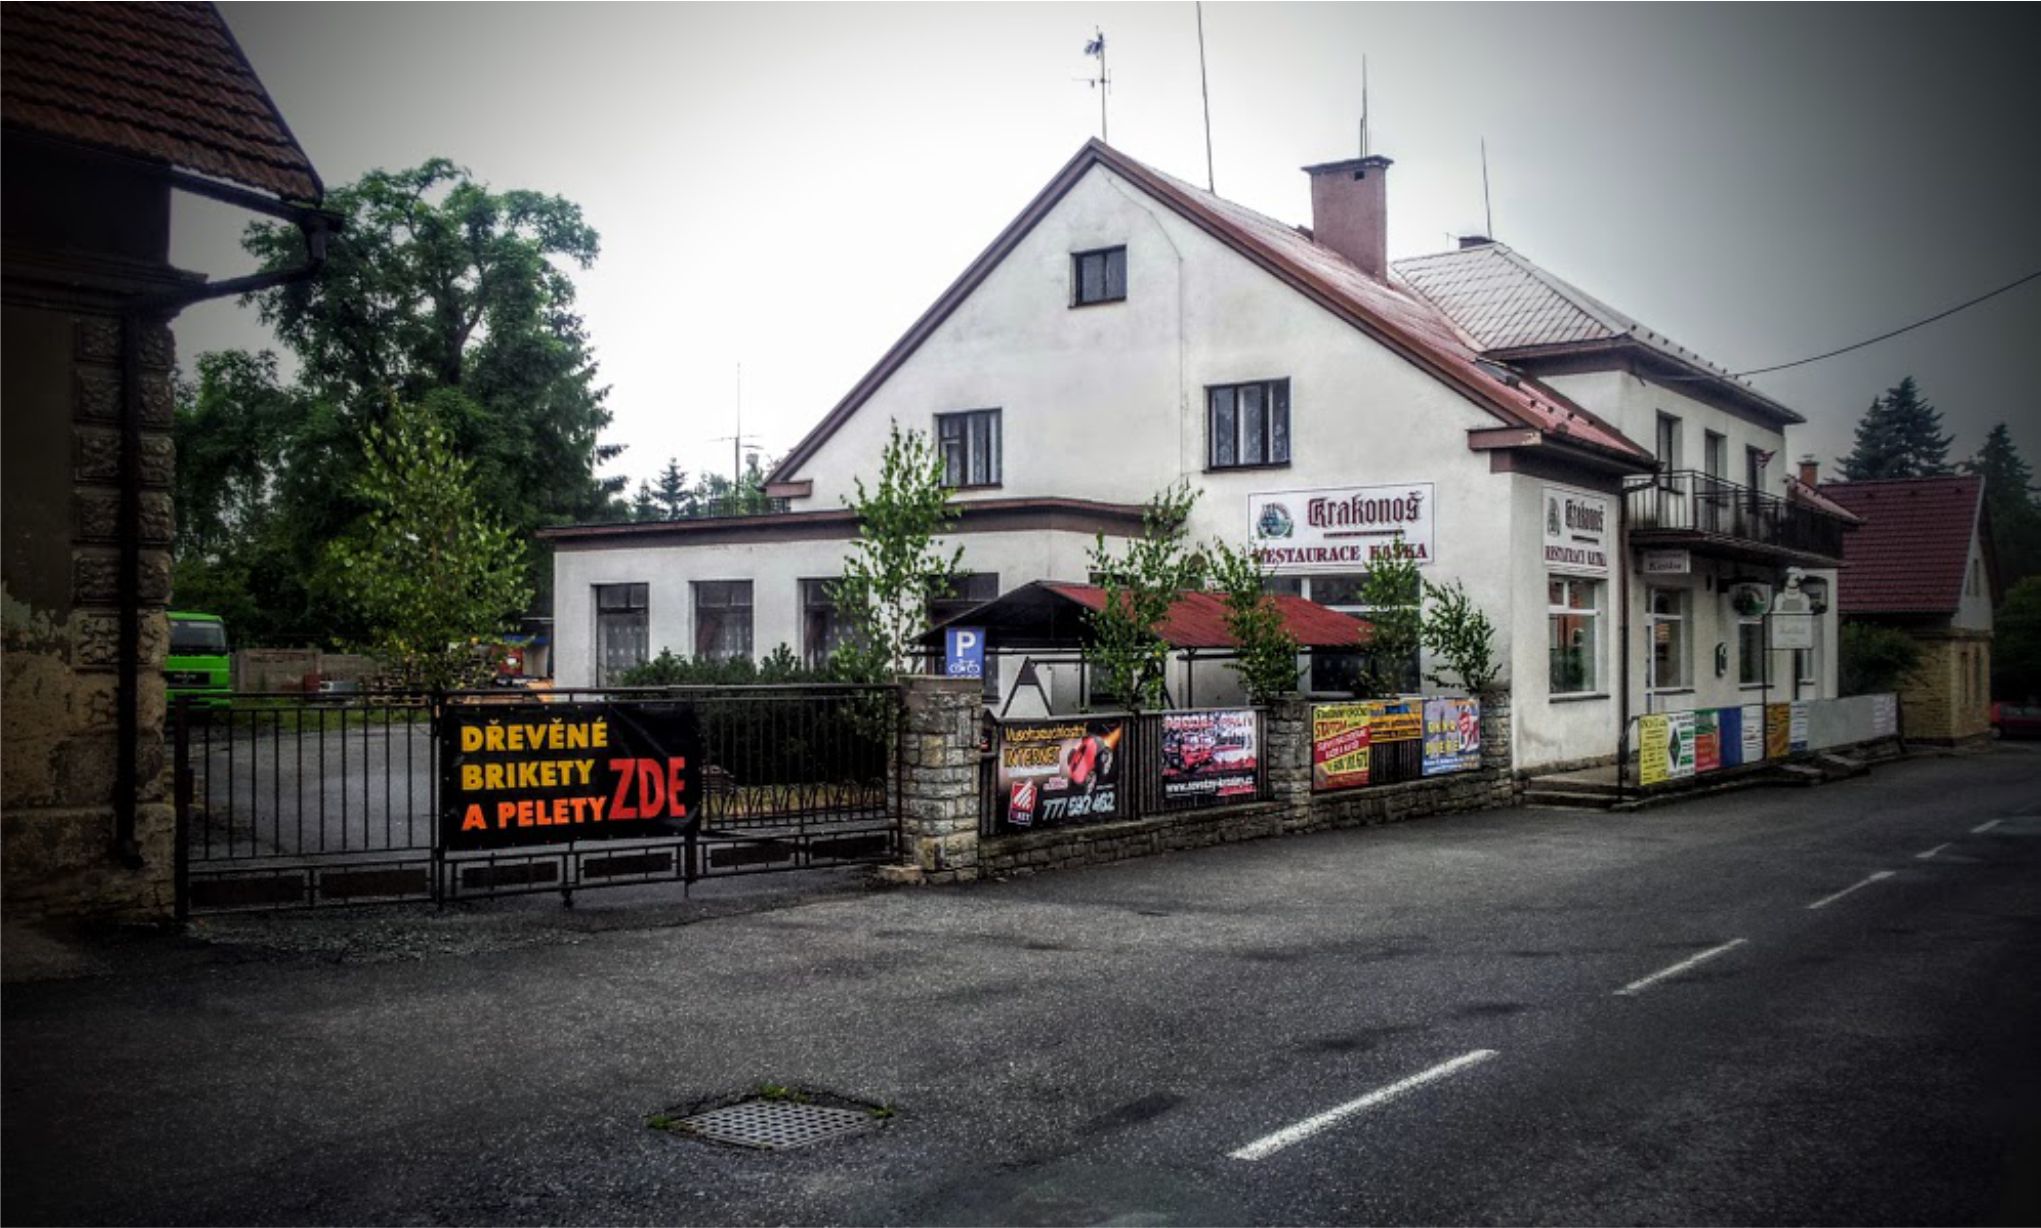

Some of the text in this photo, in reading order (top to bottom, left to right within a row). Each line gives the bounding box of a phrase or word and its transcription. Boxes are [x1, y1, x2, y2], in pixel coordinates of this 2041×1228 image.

[1308, 490, 1424, 528] Krakonoš
[956, 631, 976, 657] P
[461, 715, 608, 752] DŘEVĚNÉ
[461, 758, 595, 791] BRIKETY
[608, 756, 687, 820] ZDE
[461, 796, 607, 831] A PELETY
